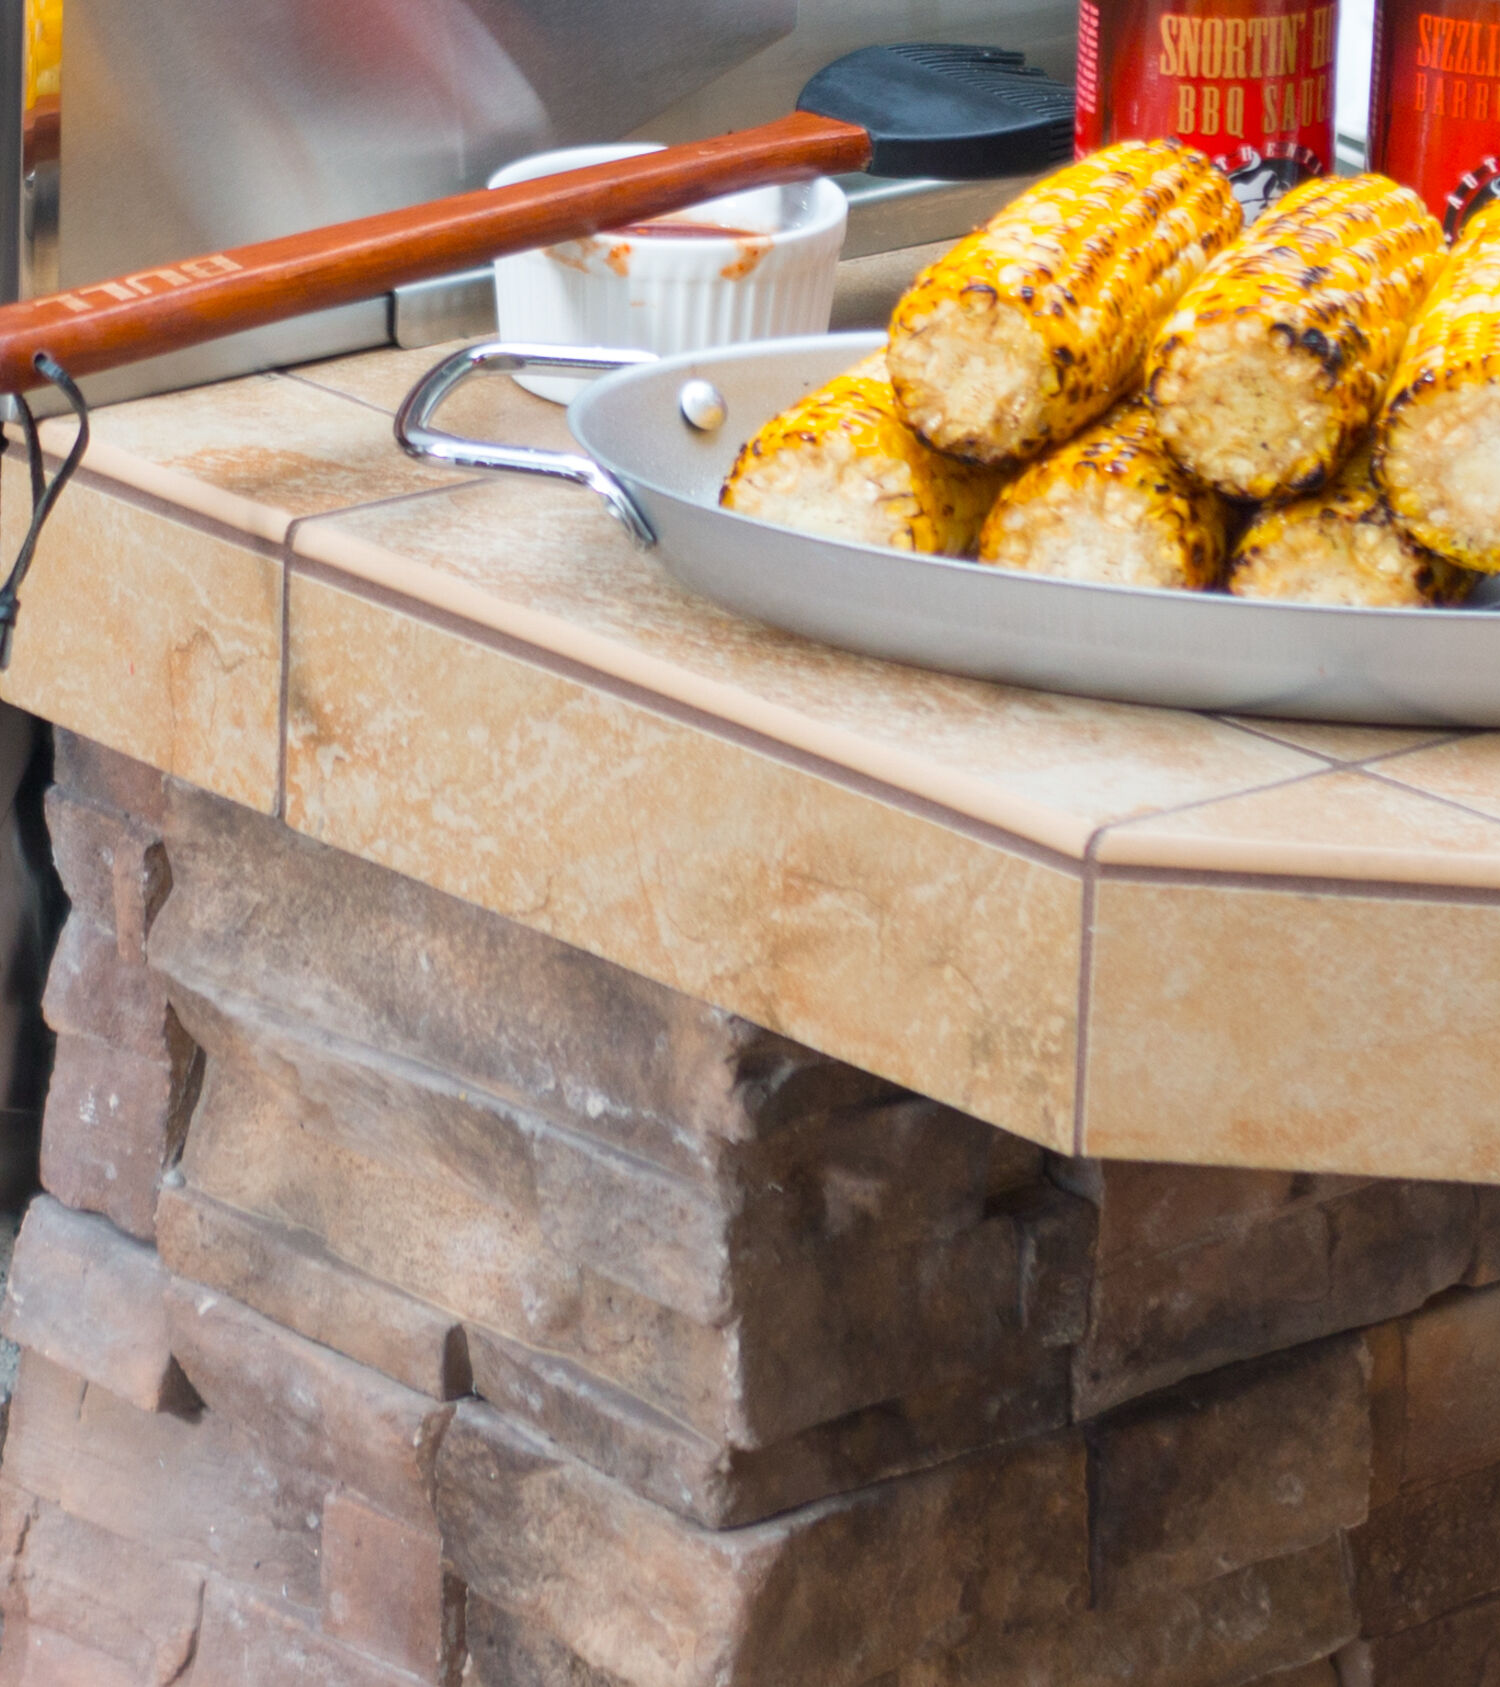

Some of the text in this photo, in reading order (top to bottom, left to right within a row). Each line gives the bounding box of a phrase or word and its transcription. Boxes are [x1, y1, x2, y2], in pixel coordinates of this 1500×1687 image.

[1159, 14, 1306, 79] SNORTIN'
[1176, 74, 1335, 140] BBQ SAUC
[33, 254, 244, 313] BULL
